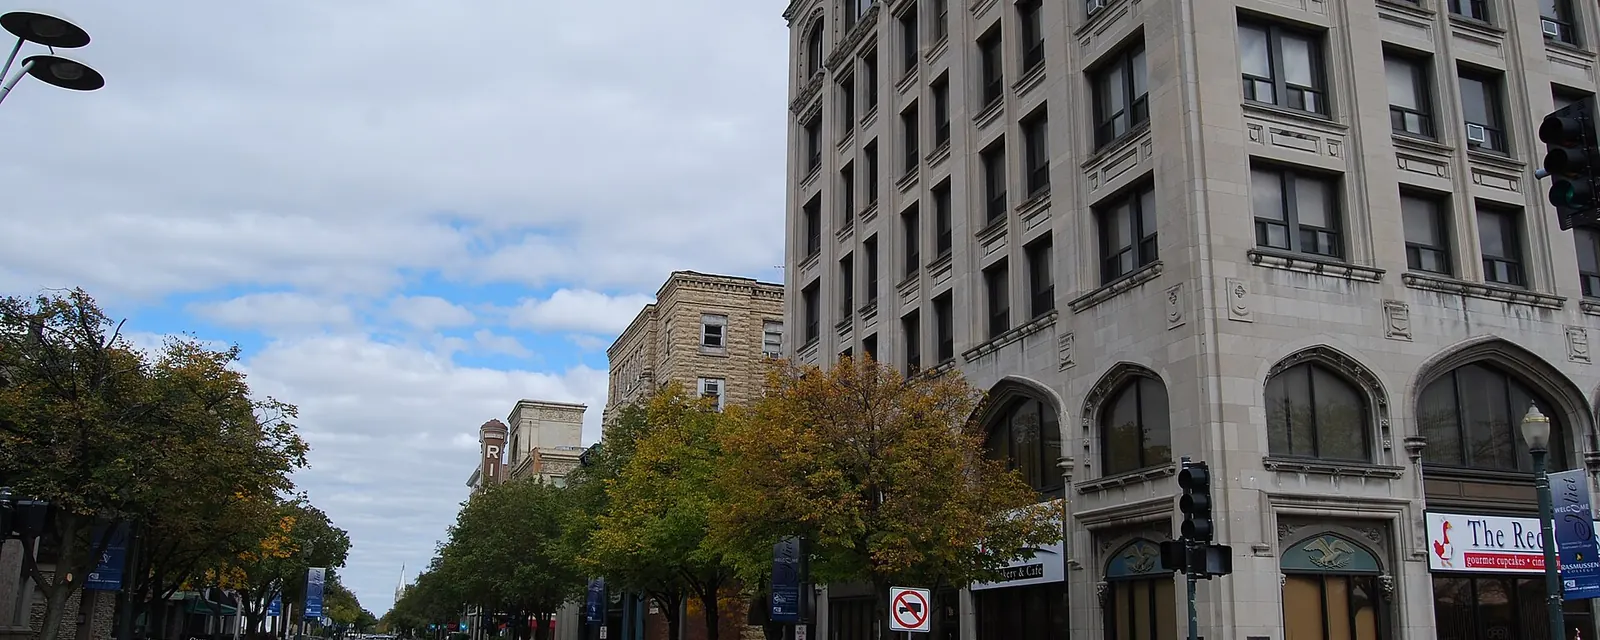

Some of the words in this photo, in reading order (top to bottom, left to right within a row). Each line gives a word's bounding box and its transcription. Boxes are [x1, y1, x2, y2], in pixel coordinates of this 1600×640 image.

[1554, 504, 1589, 513] WELCOME
[1563, 476, 1592, 541] Joliet
[1467, 519, 1505, 548] The
[1466, 556, 1495, 567] gourmet
[1496, 555, 1525, 568] cupcakes
[1561, 562, 1599, 571] RASMUSSEN
[1018, 567, 1024, 577] &
[1026, 564, 1042, 576] Cafe
